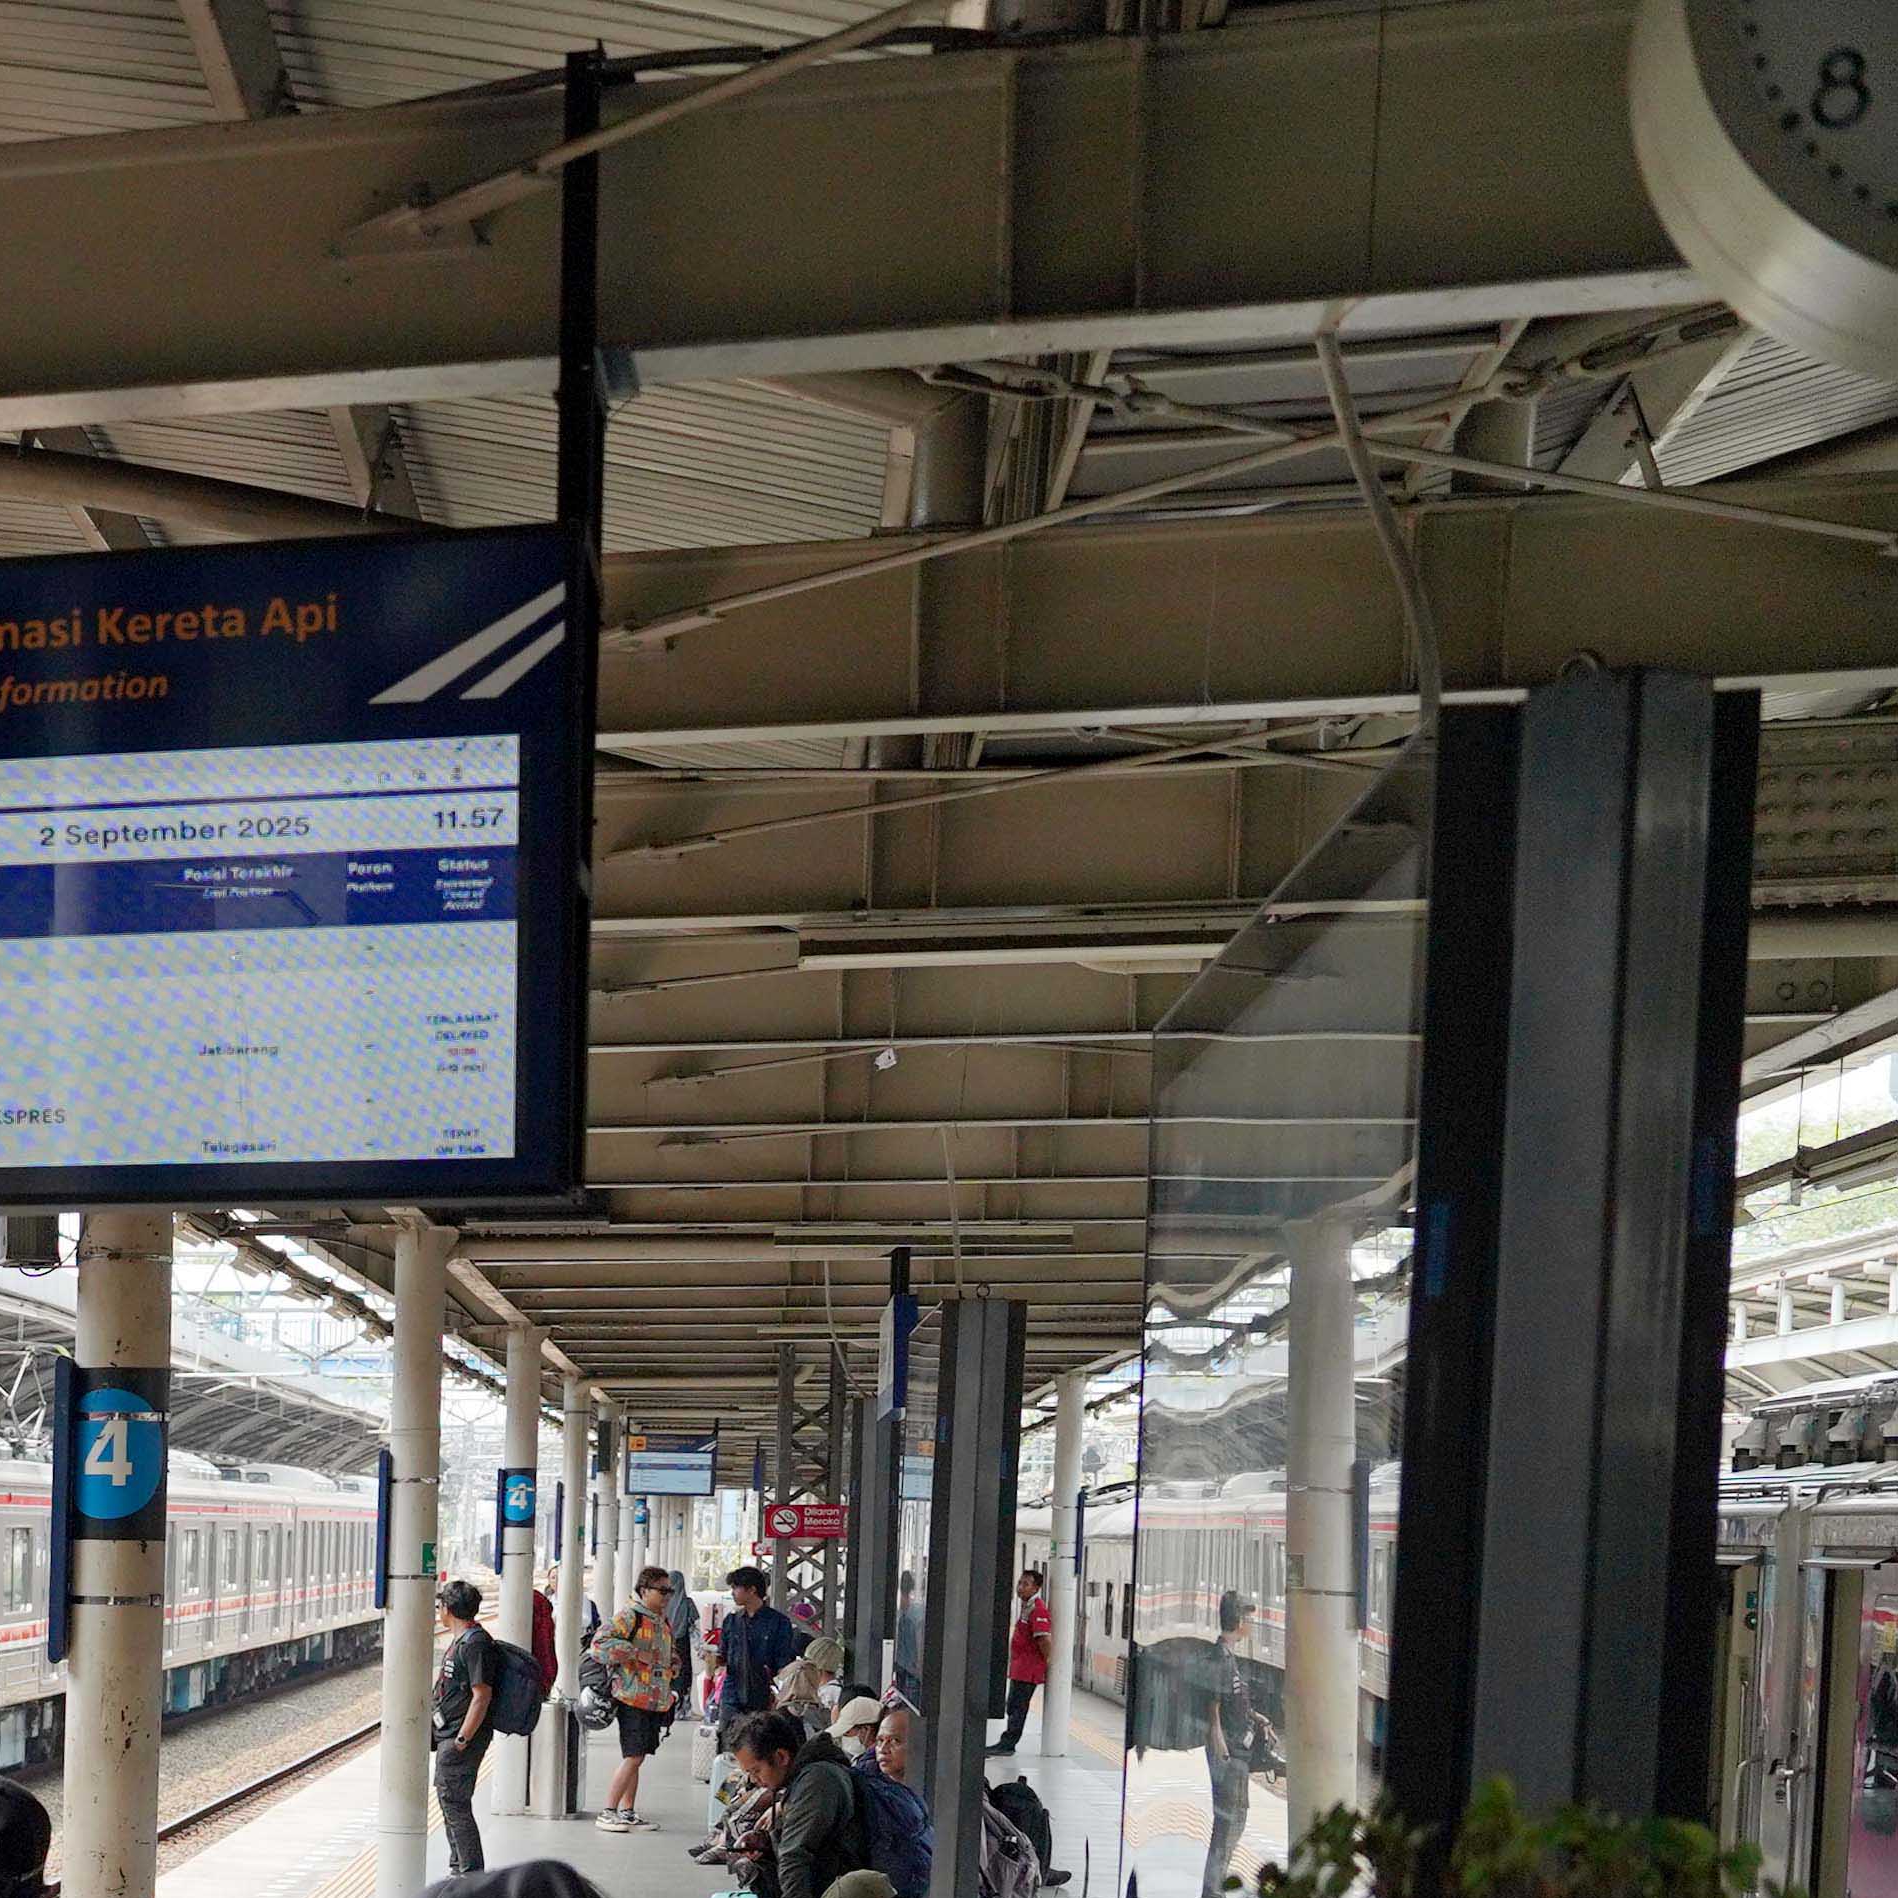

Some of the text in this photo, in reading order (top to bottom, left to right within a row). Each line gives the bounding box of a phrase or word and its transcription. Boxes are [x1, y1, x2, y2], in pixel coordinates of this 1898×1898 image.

[1809, 46, 1874, 131] 8
[97, 604, 246, 645] Kereta
[259, 593, 338, 644] Api
[39, 816, 311, 850] 2 September 2025
[432, 807, 505, 830] 11.57
[84, 1416, 133, 1486] 4
[509, 1483, 527, 1510] 4
[804, 1507, 840, 1516] Dilaran
[804, 1517, 840, 1526] Meroko
